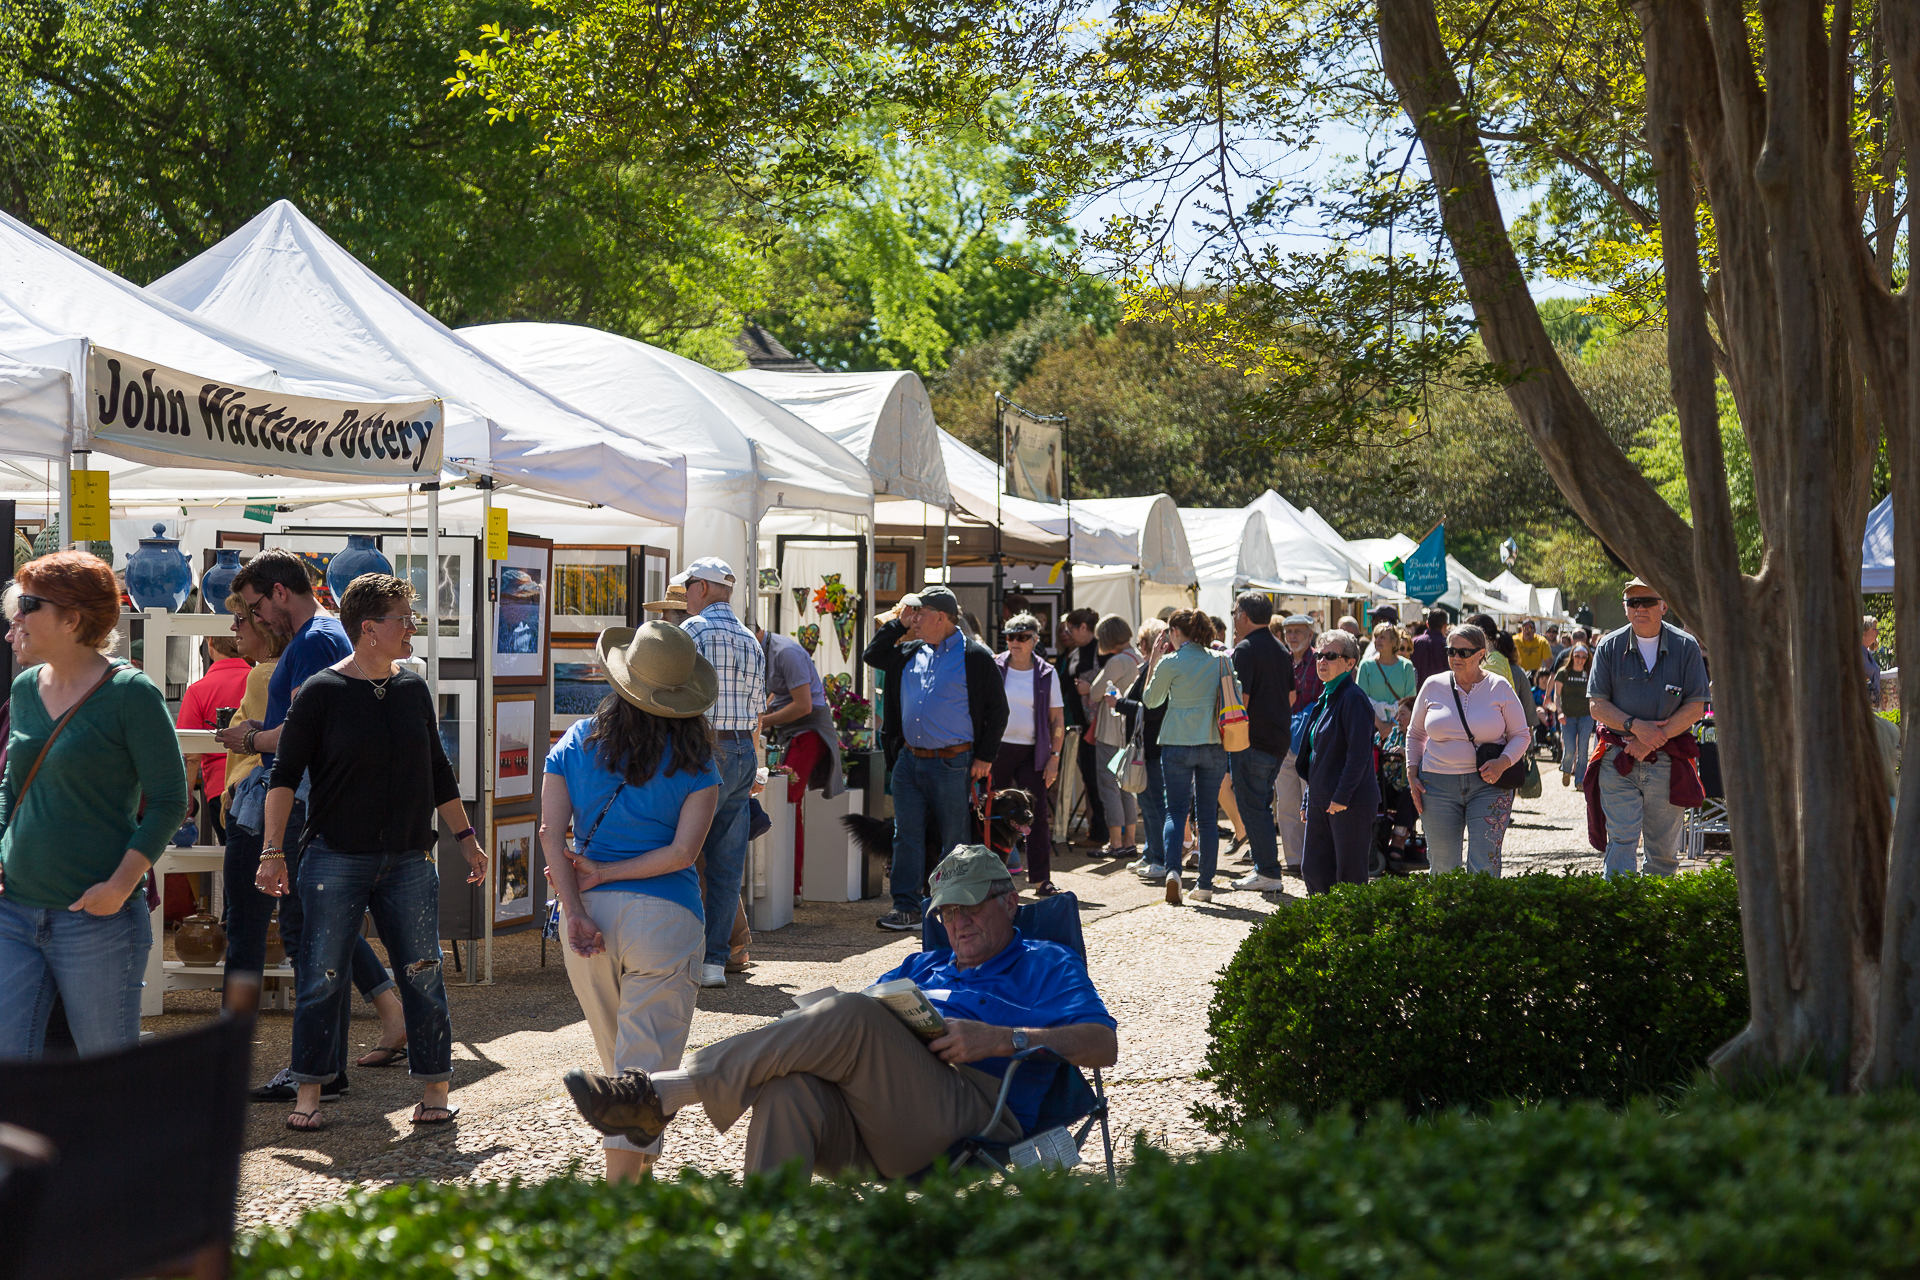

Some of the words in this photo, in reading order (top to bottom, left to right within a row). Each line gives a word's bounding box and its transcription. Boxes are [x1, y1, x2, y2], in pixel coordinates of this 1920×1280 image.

[99, 358, 191, 437] John
[198, 383, 329, 455] Watters
[321, 408, 434, 472] Pottery
[1409, 556, 1440, 570] Beverly
[1408, 570, 1438, 581] Perdue
